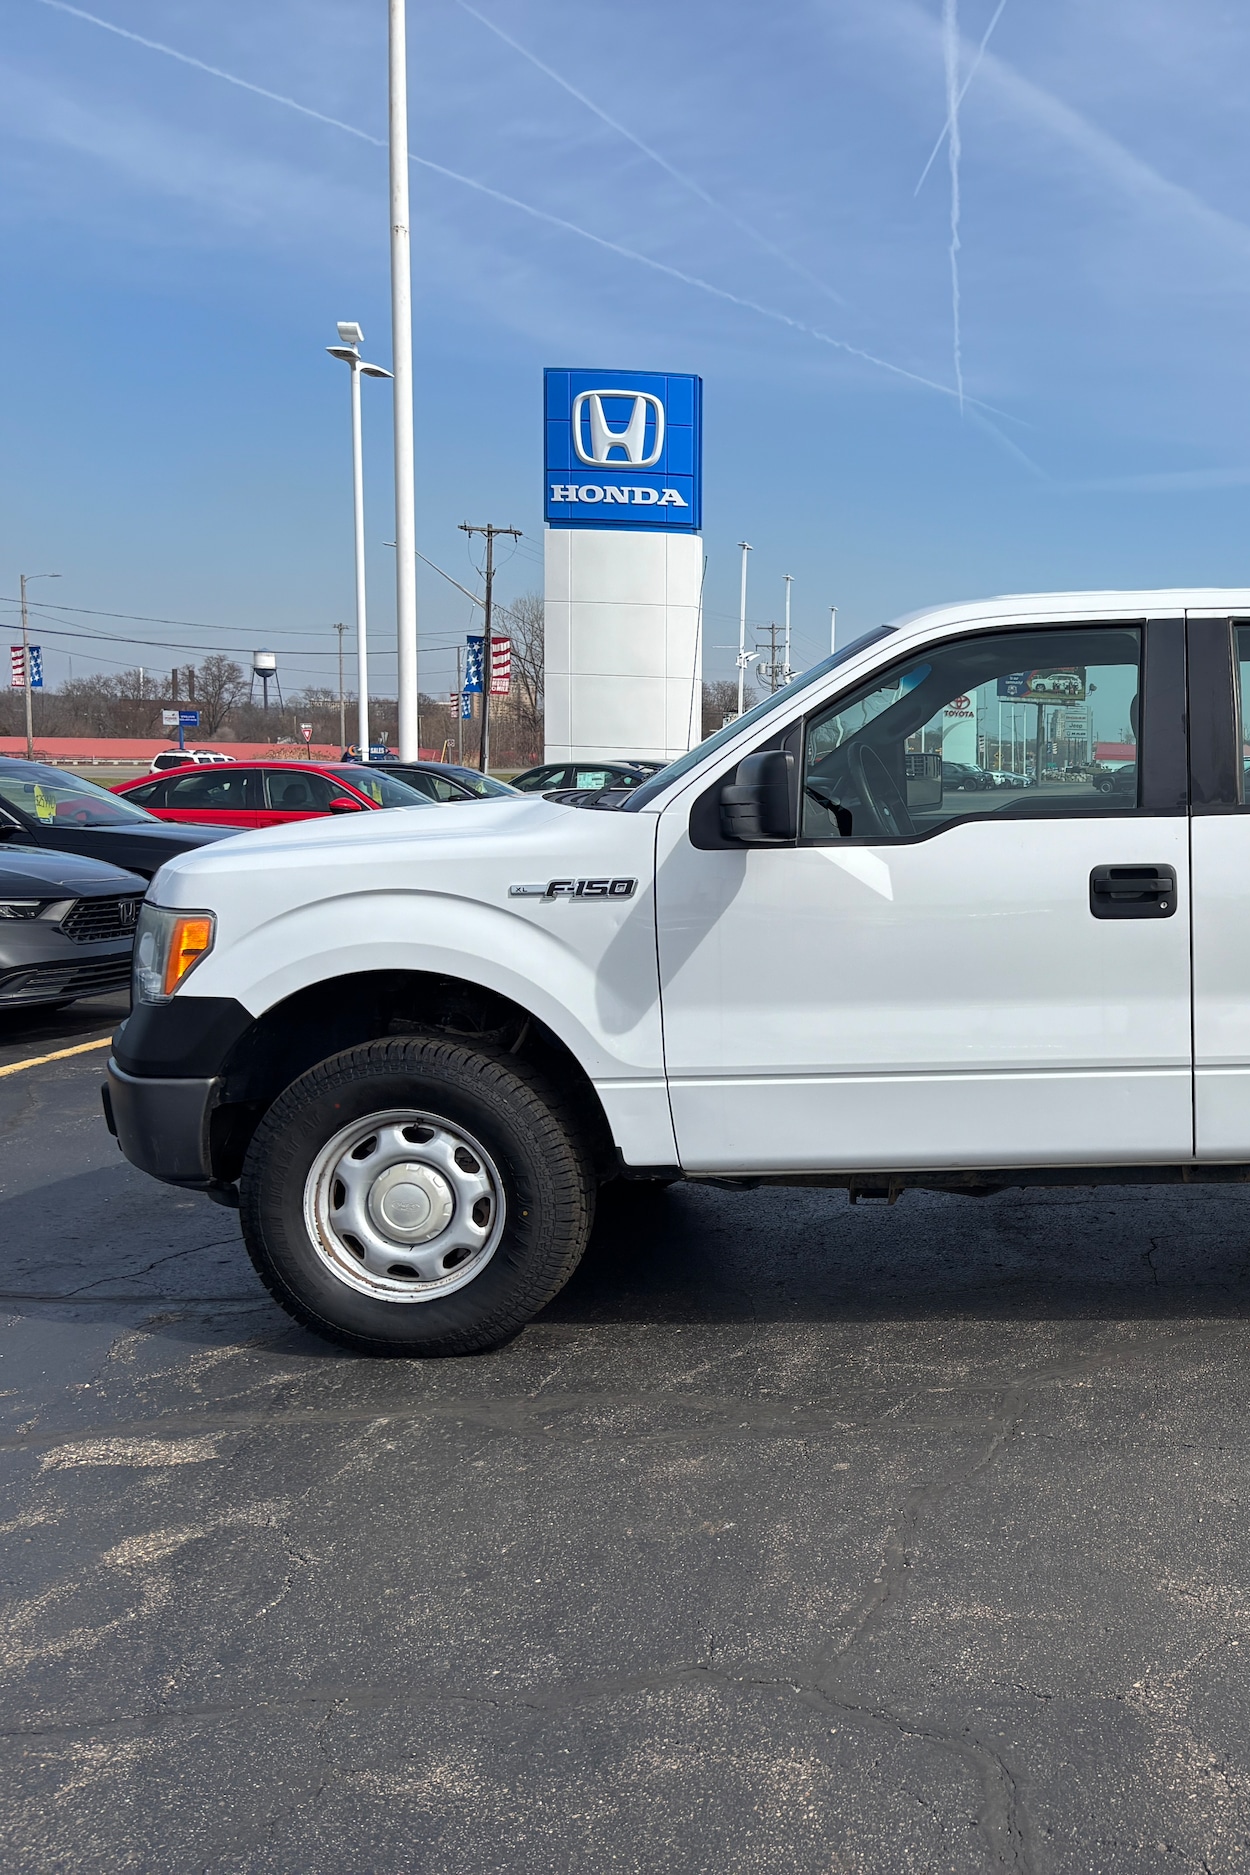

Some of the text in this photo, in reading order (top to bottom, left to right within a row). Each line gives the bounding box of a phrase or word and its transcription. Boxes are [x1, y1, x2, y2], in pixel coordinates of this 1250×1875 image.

[550, 484, 688, 507] HONDA
[943, 710, 975, 718] TOYOTA
[544, 878, 639, 899] F-150
